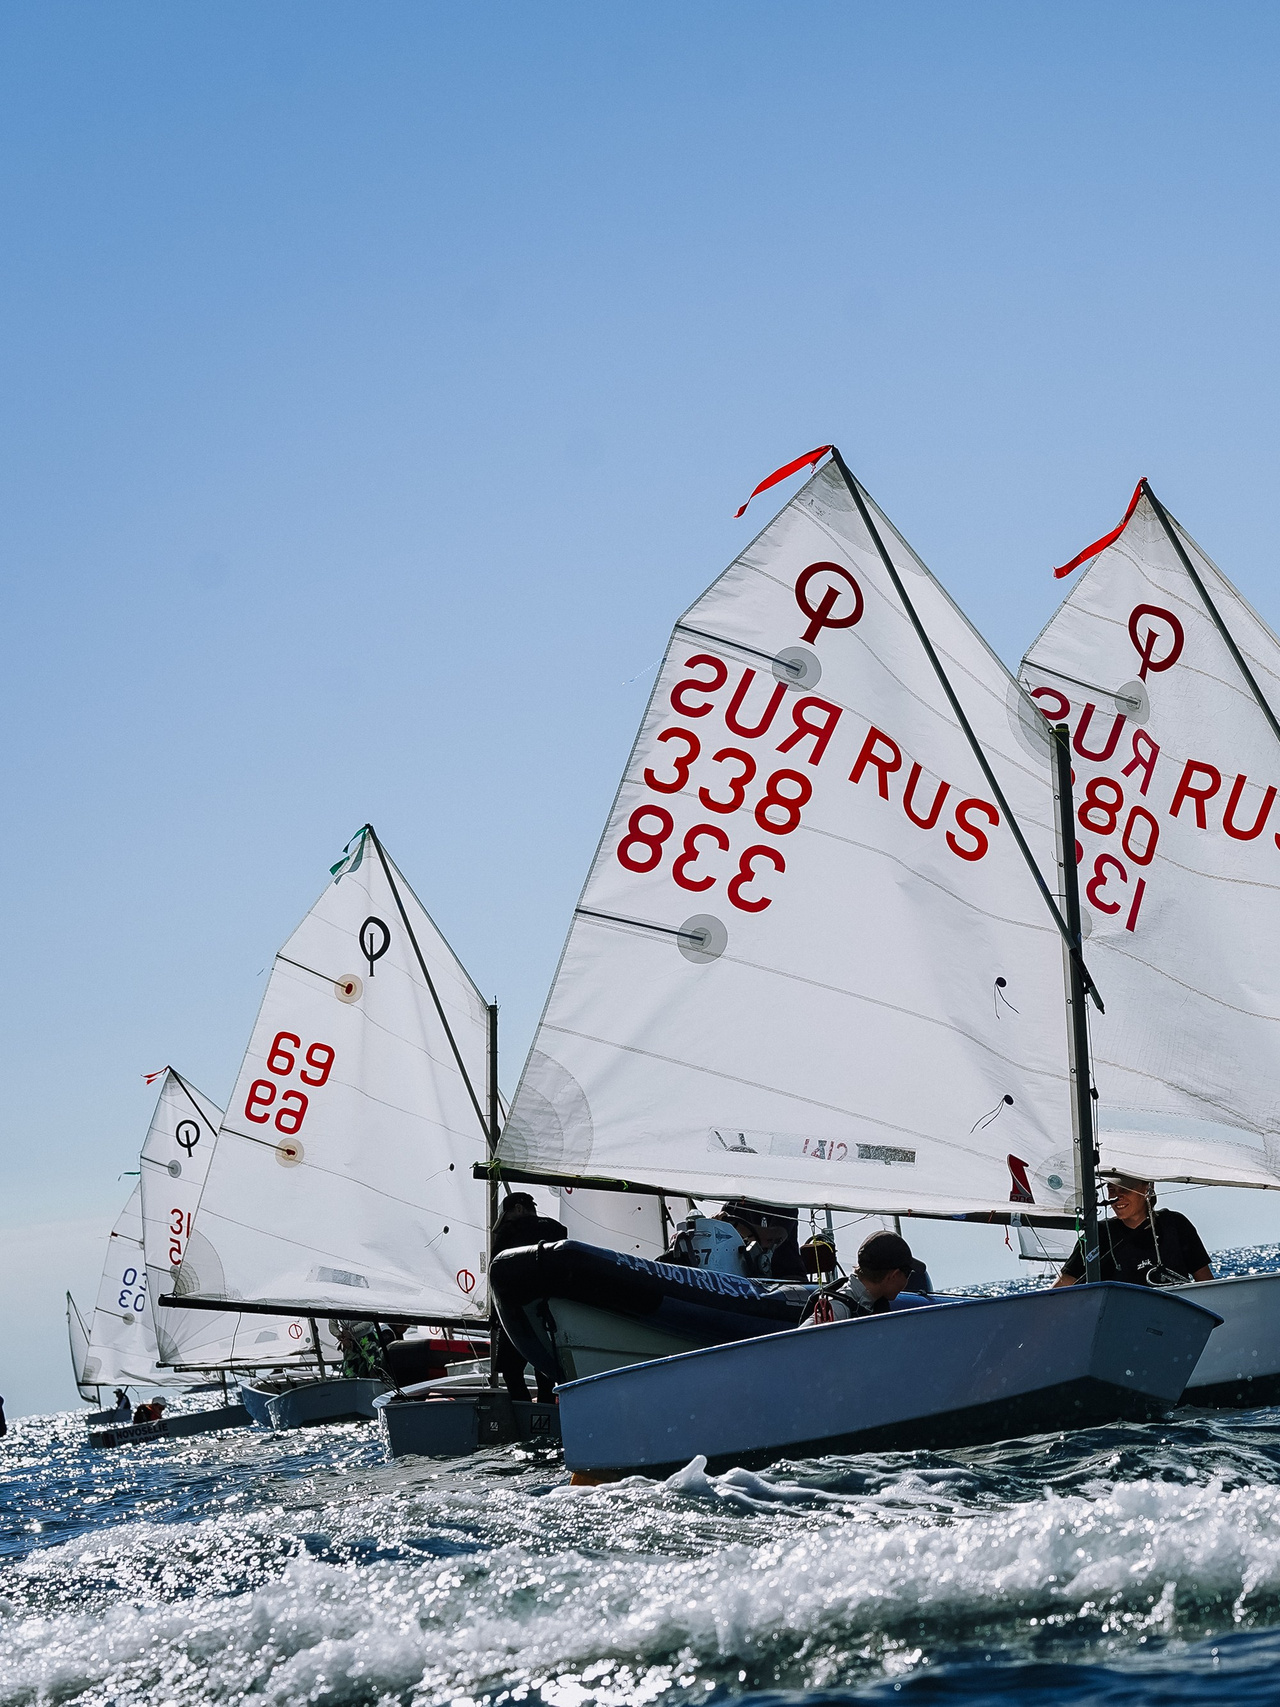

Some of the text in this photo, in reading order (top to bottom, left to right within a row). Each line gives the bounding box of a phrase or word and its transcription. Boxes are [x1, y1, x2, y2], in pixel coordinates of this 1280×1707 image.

[643, 727, 813, 835] 338
[848, 725, 1000, 862] RUS
[266, 1031, 336, 1088] 69
[1137, 1259, 1152, 1270] zhik
[116, 1423, 168, 1440] NOVOSELIE
